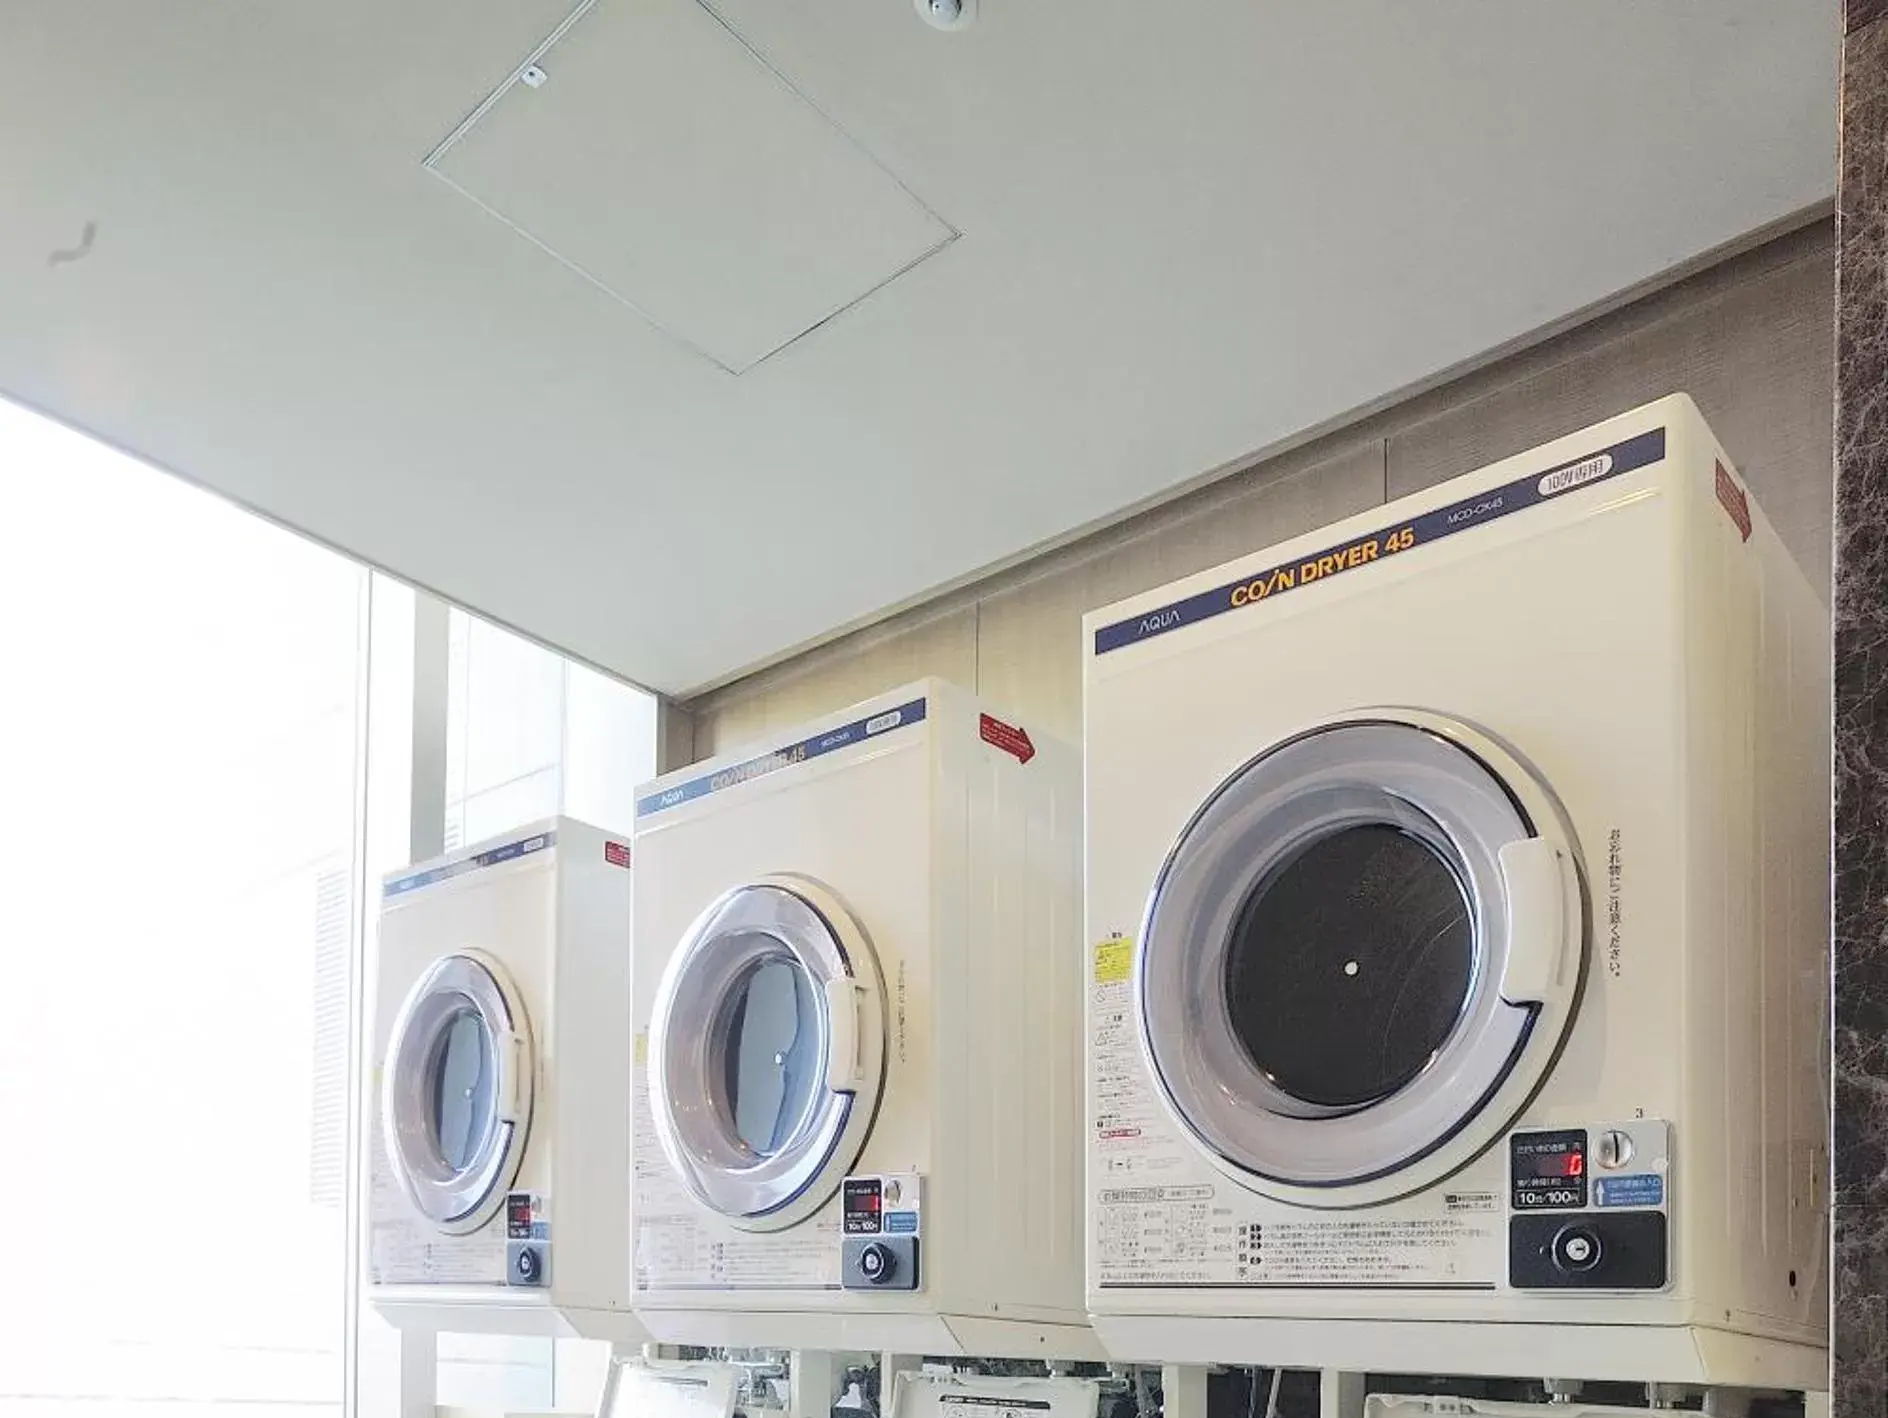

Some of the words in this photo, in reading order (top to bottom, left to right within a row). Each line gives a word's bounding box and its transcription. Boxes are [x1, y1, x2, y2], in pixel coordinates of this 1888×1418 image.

[1139, 610, 1181, 635] AQUA
[1230, 568, 1295, 607] COIN
[1301, 540, 1379, 585] DRYER
[1385, 527, 1415, 553] 45
